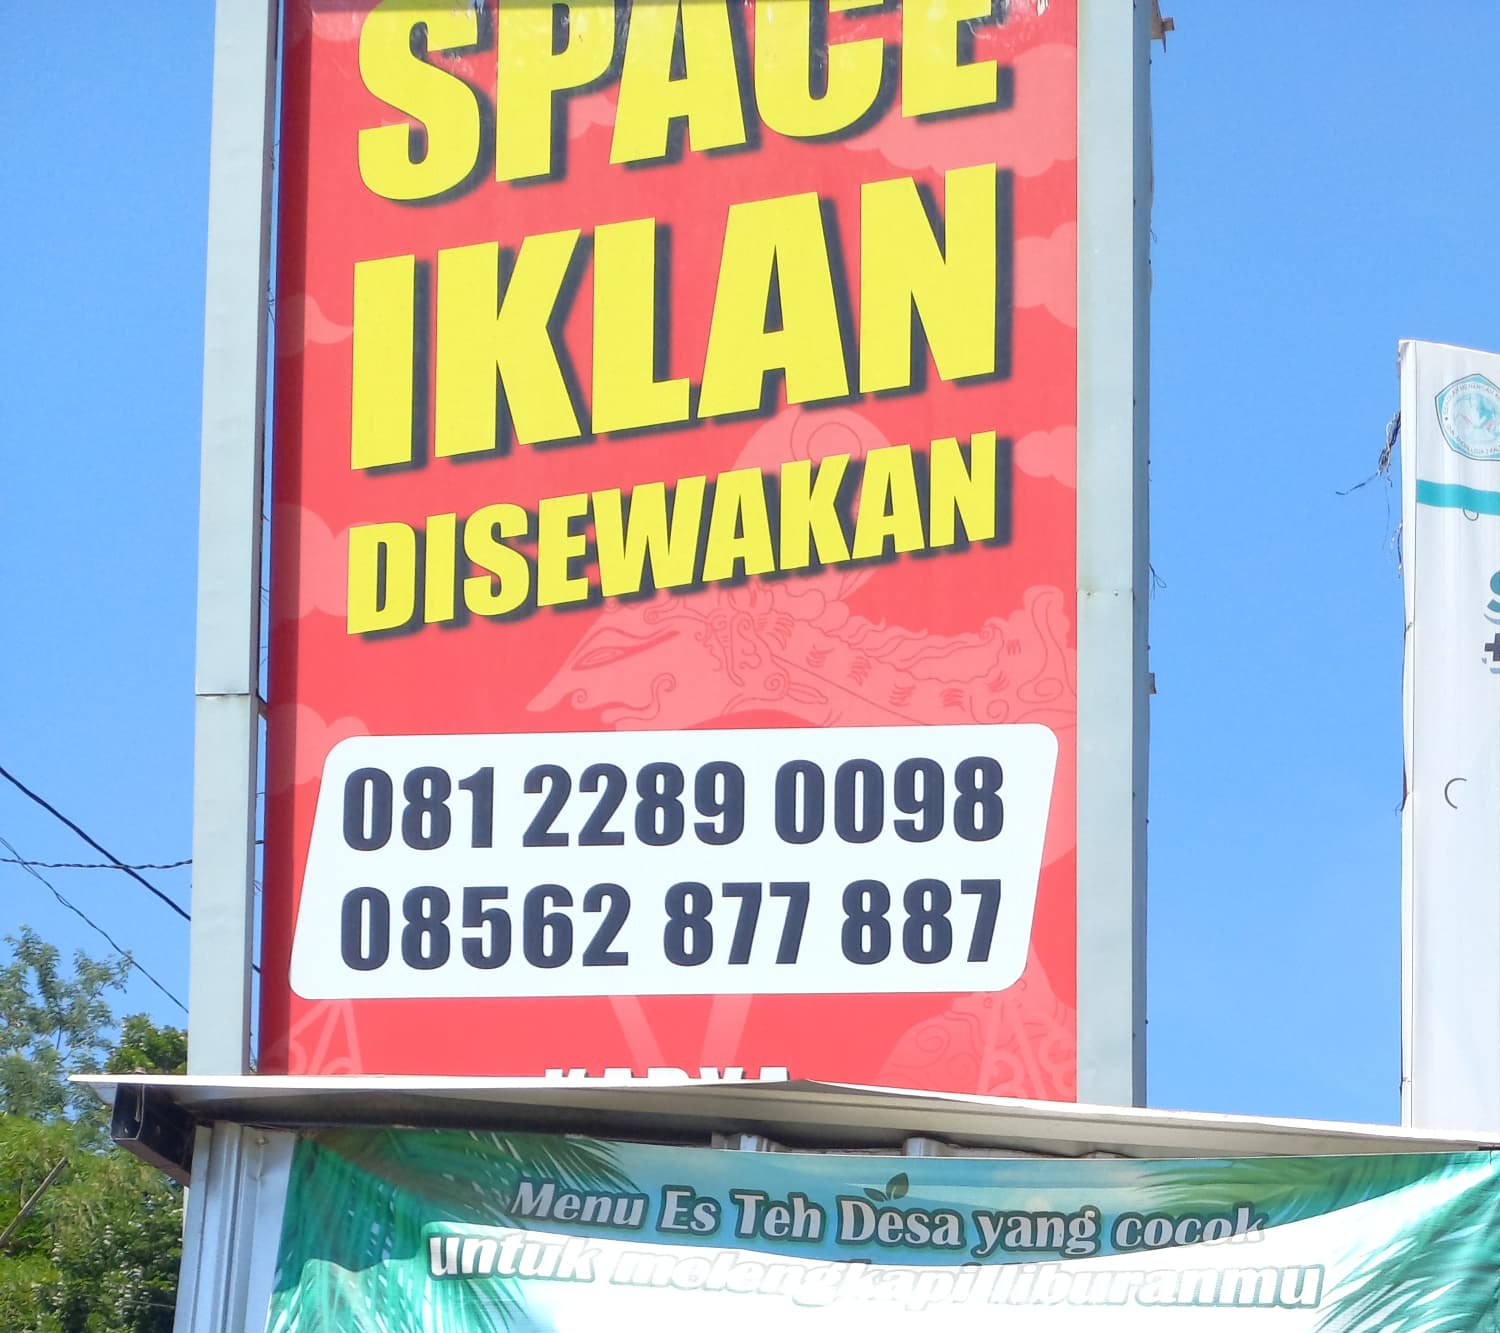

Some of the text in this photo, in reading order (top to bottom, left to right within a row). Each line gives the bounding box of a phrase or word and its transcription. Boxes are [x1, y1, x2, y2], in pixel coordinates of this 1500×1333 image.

[356, 0, 998, 200] SPACE
[350, 163, 997, 470] IKLAN
[347, 430, 996, 636] DISEWAKAN
[342, 755, 1003, 851] 081 2289 0098
[340, 877, 1002, 971] 08562 877 887
[508, 1180, 1266, 1257] Menu Es Teh Desa yang cocok
[428, 1229, 602, 1282] untuk
[984, 1262, 1324, 1309] liburanmu
